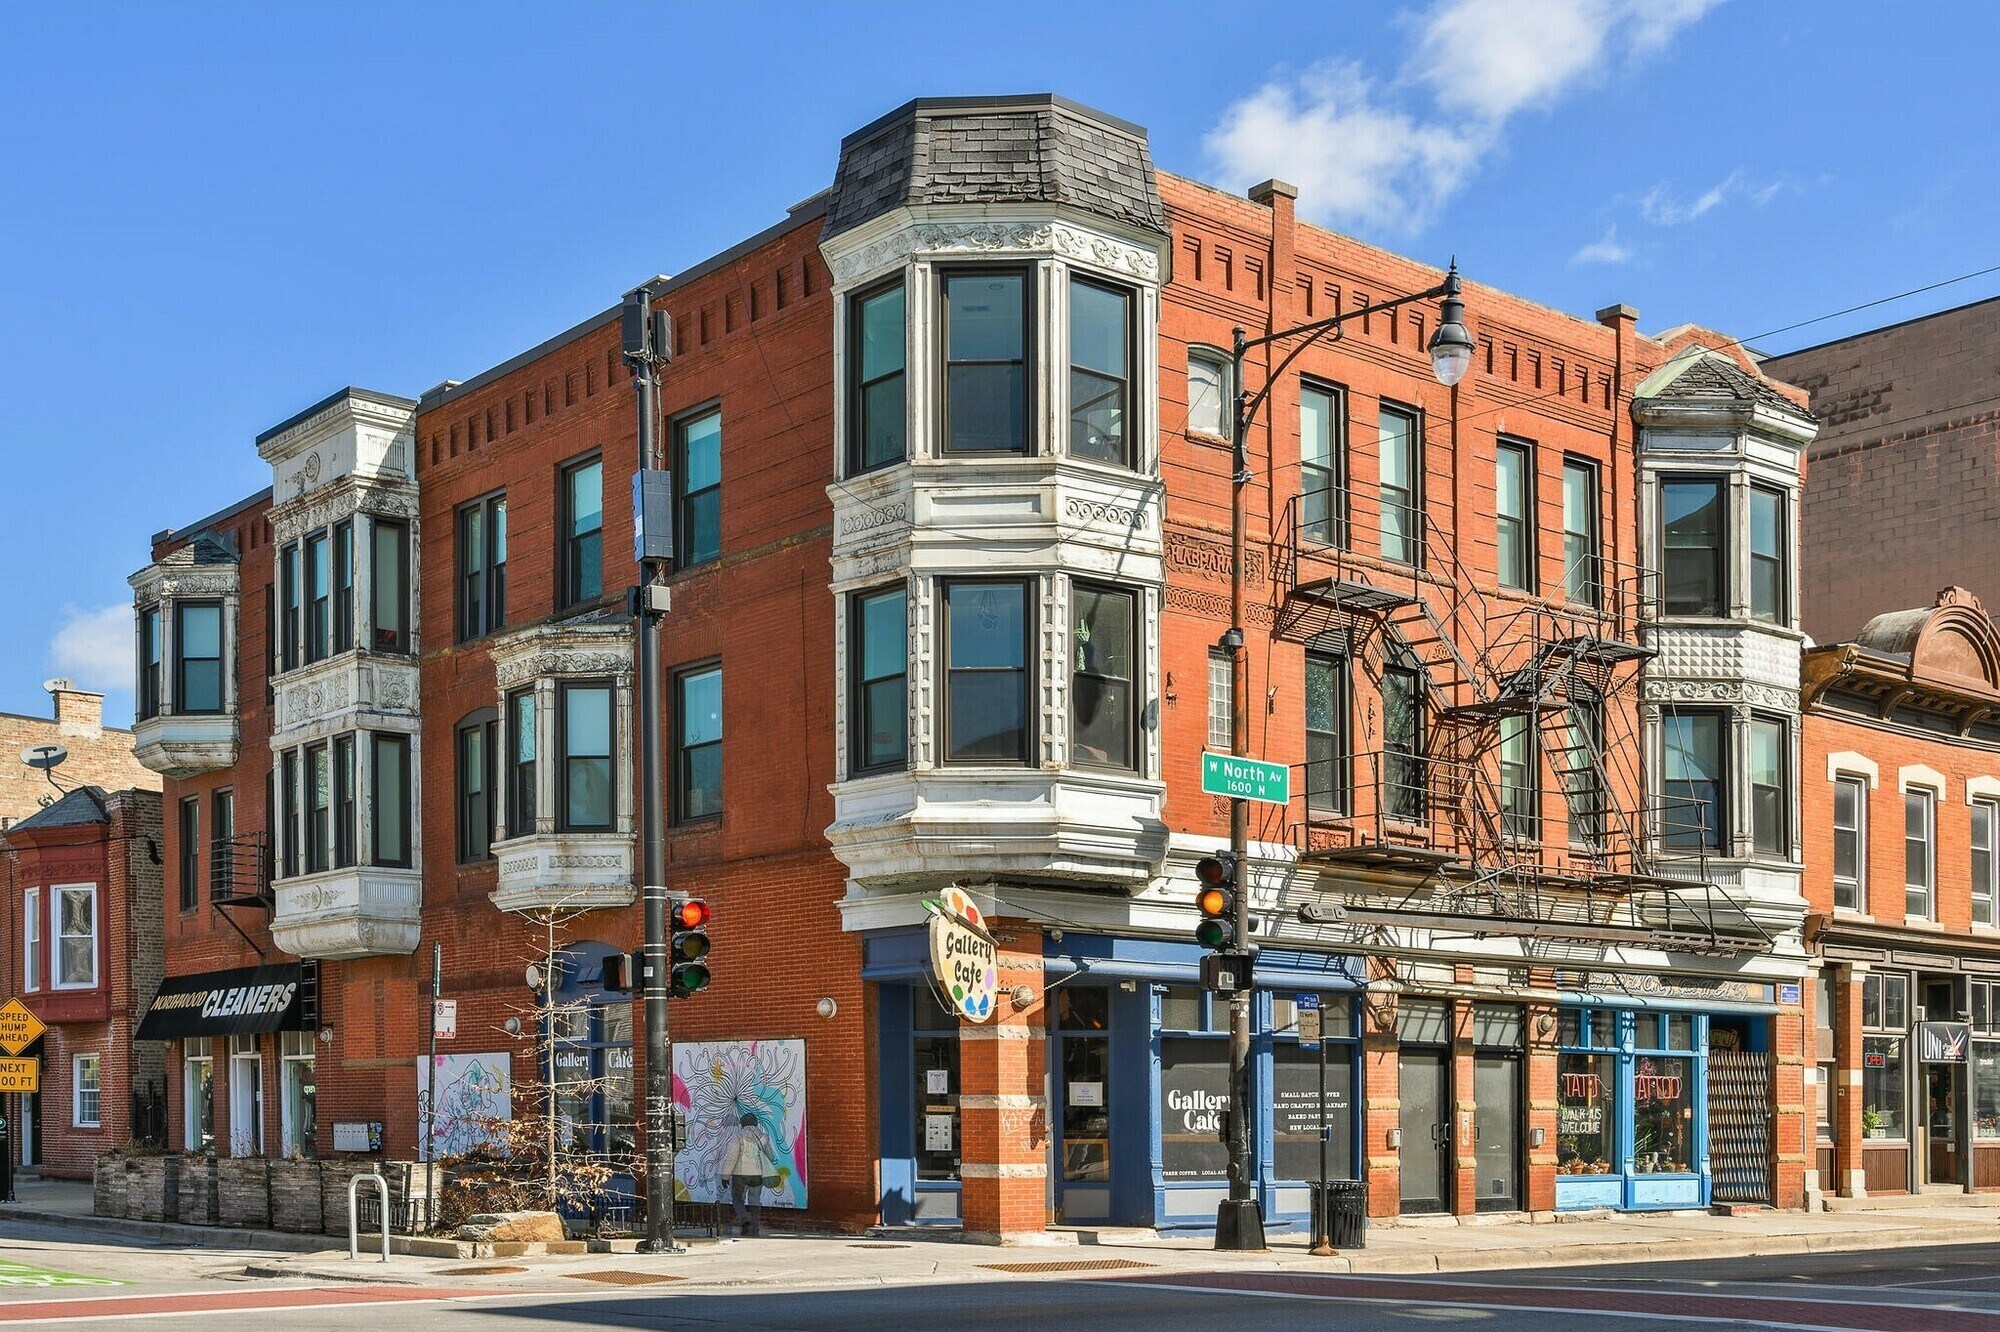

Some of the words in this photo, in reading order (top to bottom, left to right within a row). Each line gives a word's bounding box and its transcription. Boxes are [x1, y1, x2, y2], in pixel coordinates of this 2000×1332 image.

[1209, 760, 1218, 772] W
[1224, 761, 1265, 782] North
[1269, 771, 1282, 783] Av
[1227, 780, 1252, 793] 1600
[1258, 785, 1265, 796] N
[945, 931, 992, 965] Gallery
[954, 959, 982, 994] Cafe
[150, 990, 209, 1011] NORTHWOOD
[201, 982, 296, 1019] CLEANERS
[0, 1012, 29, 1022] SPEED
[1, 1023, 27, 1032] HUMP
[0, 1033, 29, 1042] AHEAD
[1866, 1054, 1884, 1065] OPEN
[0, 1063, 27, 1073] NEXT
[1, 1076, 16, 1087] 00
[20, 1077, 33, 1087] FT
[303, 1085, 316, 1095] open
[1183, 1110, 1221, 1131] Cafe
[1561, 1121, 1601, 1135] WELCOME
